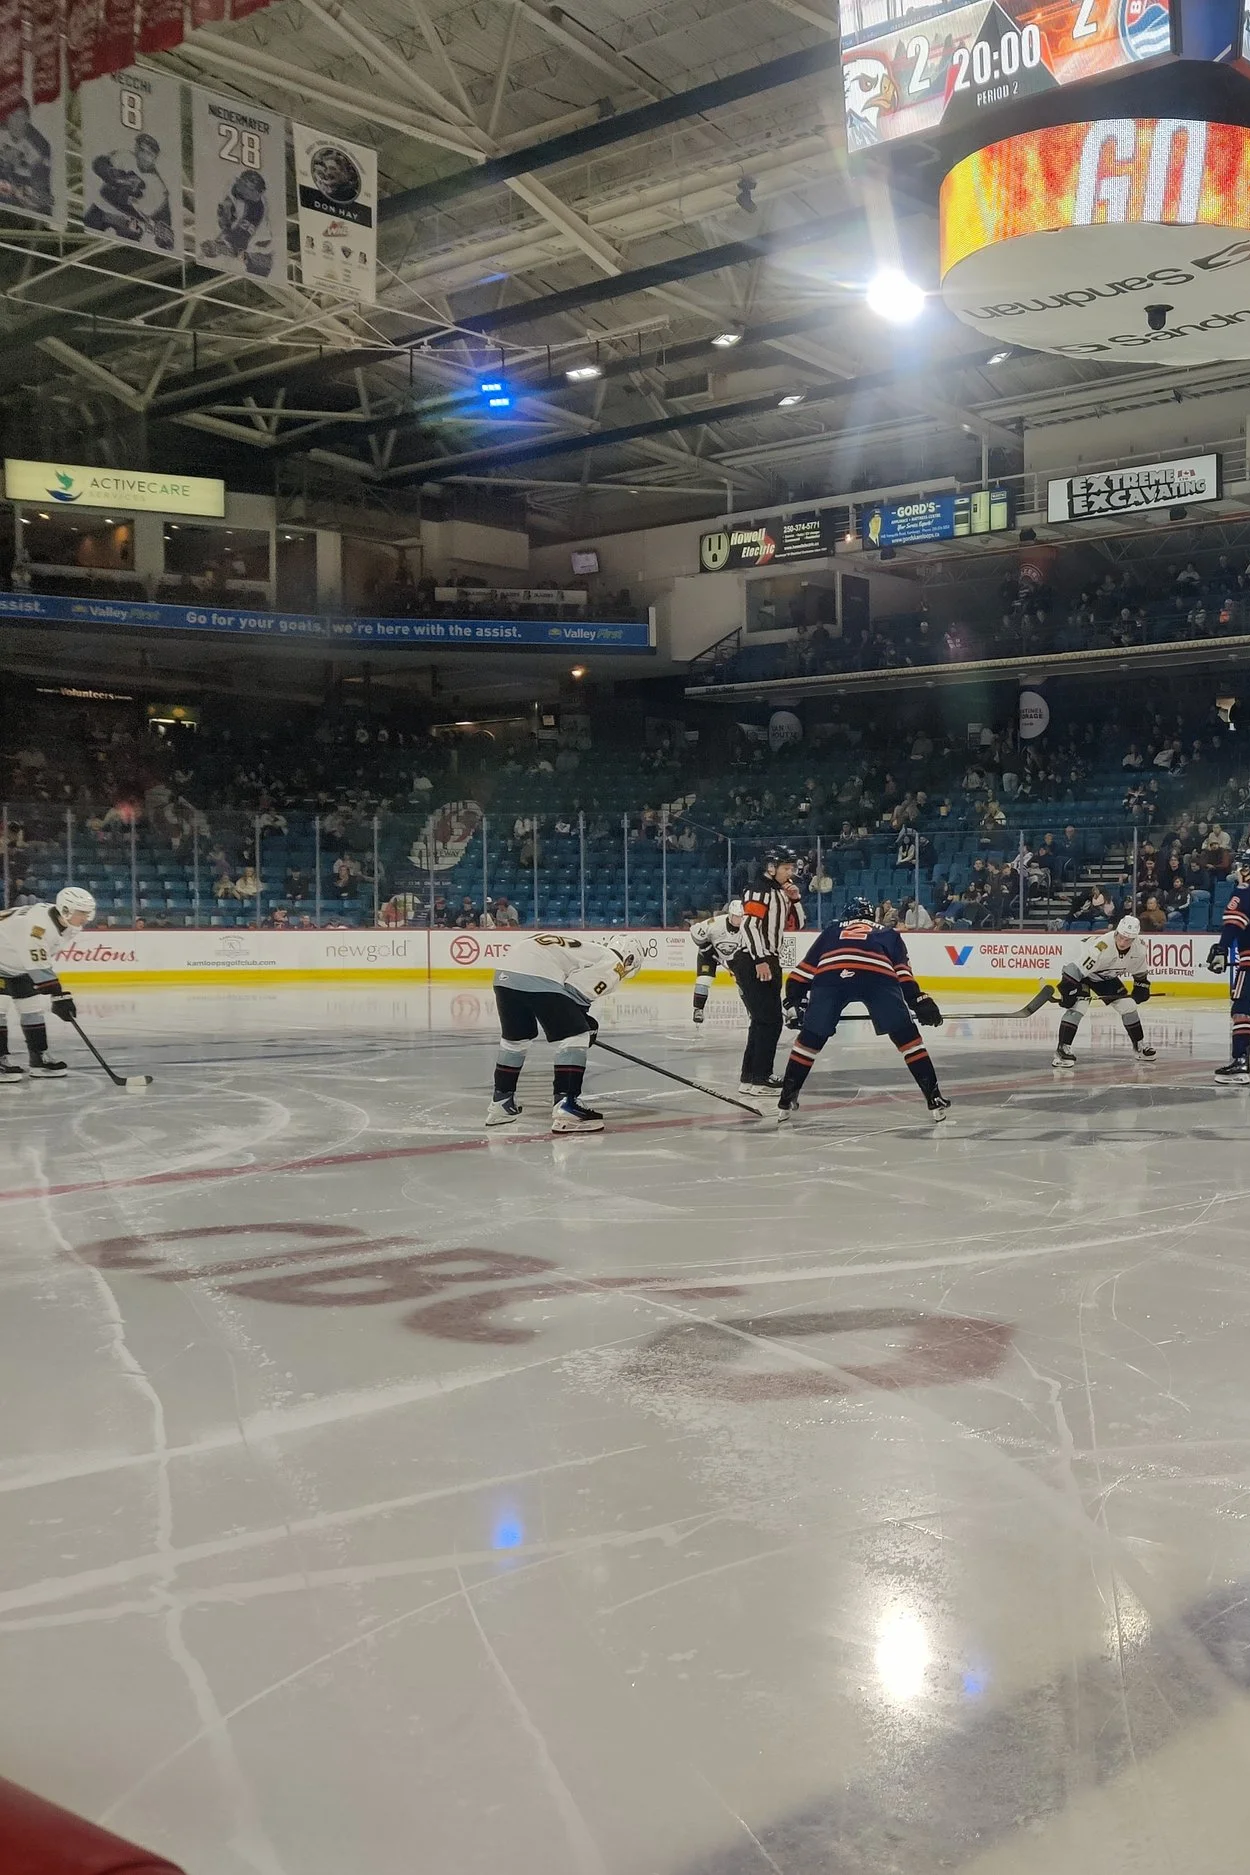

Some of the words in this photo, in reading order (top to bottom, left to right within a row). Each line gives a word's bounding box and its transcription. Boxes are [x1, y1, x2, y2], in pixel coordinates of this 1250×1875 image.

[1072, 0, 1098, 40] 2
[908, 36, 931, 96] 2
[952, 23, 1041, 93] 20:00
[976, 84, 1010, 107] PERIOD
[1011, 81, 1020, 96] 2
[120, 89, 144, 131] 8
[208, 103, 270, 136] NIEDERMAYER
[218, 123, 262, 170] 28
[1072, 118, 1208, 226] GO
[314, 200, 336, 214] DON
[338, 208, 359, 221] HAY
[961, 268, 1195, 320] Sandman
[90, 477, 192, 497] ACTIVECARE
[1067, 469, 1176, 498] EXTREME
[1068, 479, 1207, 519] EXCAVATING
[730, 528, 766, 546] Howell
[741, 544, 775, 559] Electric
[0, 599, 46, 613] ssist.
[90, 605, 129, 621] Valley
[185, 611, 207, 624] Go
[211, 613, 234, 626] for
[239, 616, 274, 631] your
[332, 621, 372, 634] we're
[377, 620, 410, 635] here
[413, 622, 446, 636] with
[448, 623, 472, 637] the
[475, 624, 523, 638] assist.
[563, 628, 597, 641] Valley
[59, 687, 115, 701] Volunteers
[697, 927, 707, 939] 12
[839, 923, 873, 940] 2
[29, 949, 47, 962] 59
[54, 940, 136, 964] Hortons
[325, 940, 408, 963] newgold
[979, 944, 1009, 955] GREAT
[1011, 944, 1063, 956] CANADIAN
[1146, 938, 1194, 968] land
[186, 958, 276, 968] kamloopsgolfclub.com
[990, 958, 1006, 969] OIL
[1008, 958, 1050, 969] CHANGE
[1082, 955, 1096, 971] 15
[1155, 968, 1168, 976] LIFE
[1168, 967, 1195, 977] BETTER!
[594, 980, 607, 995] 8
